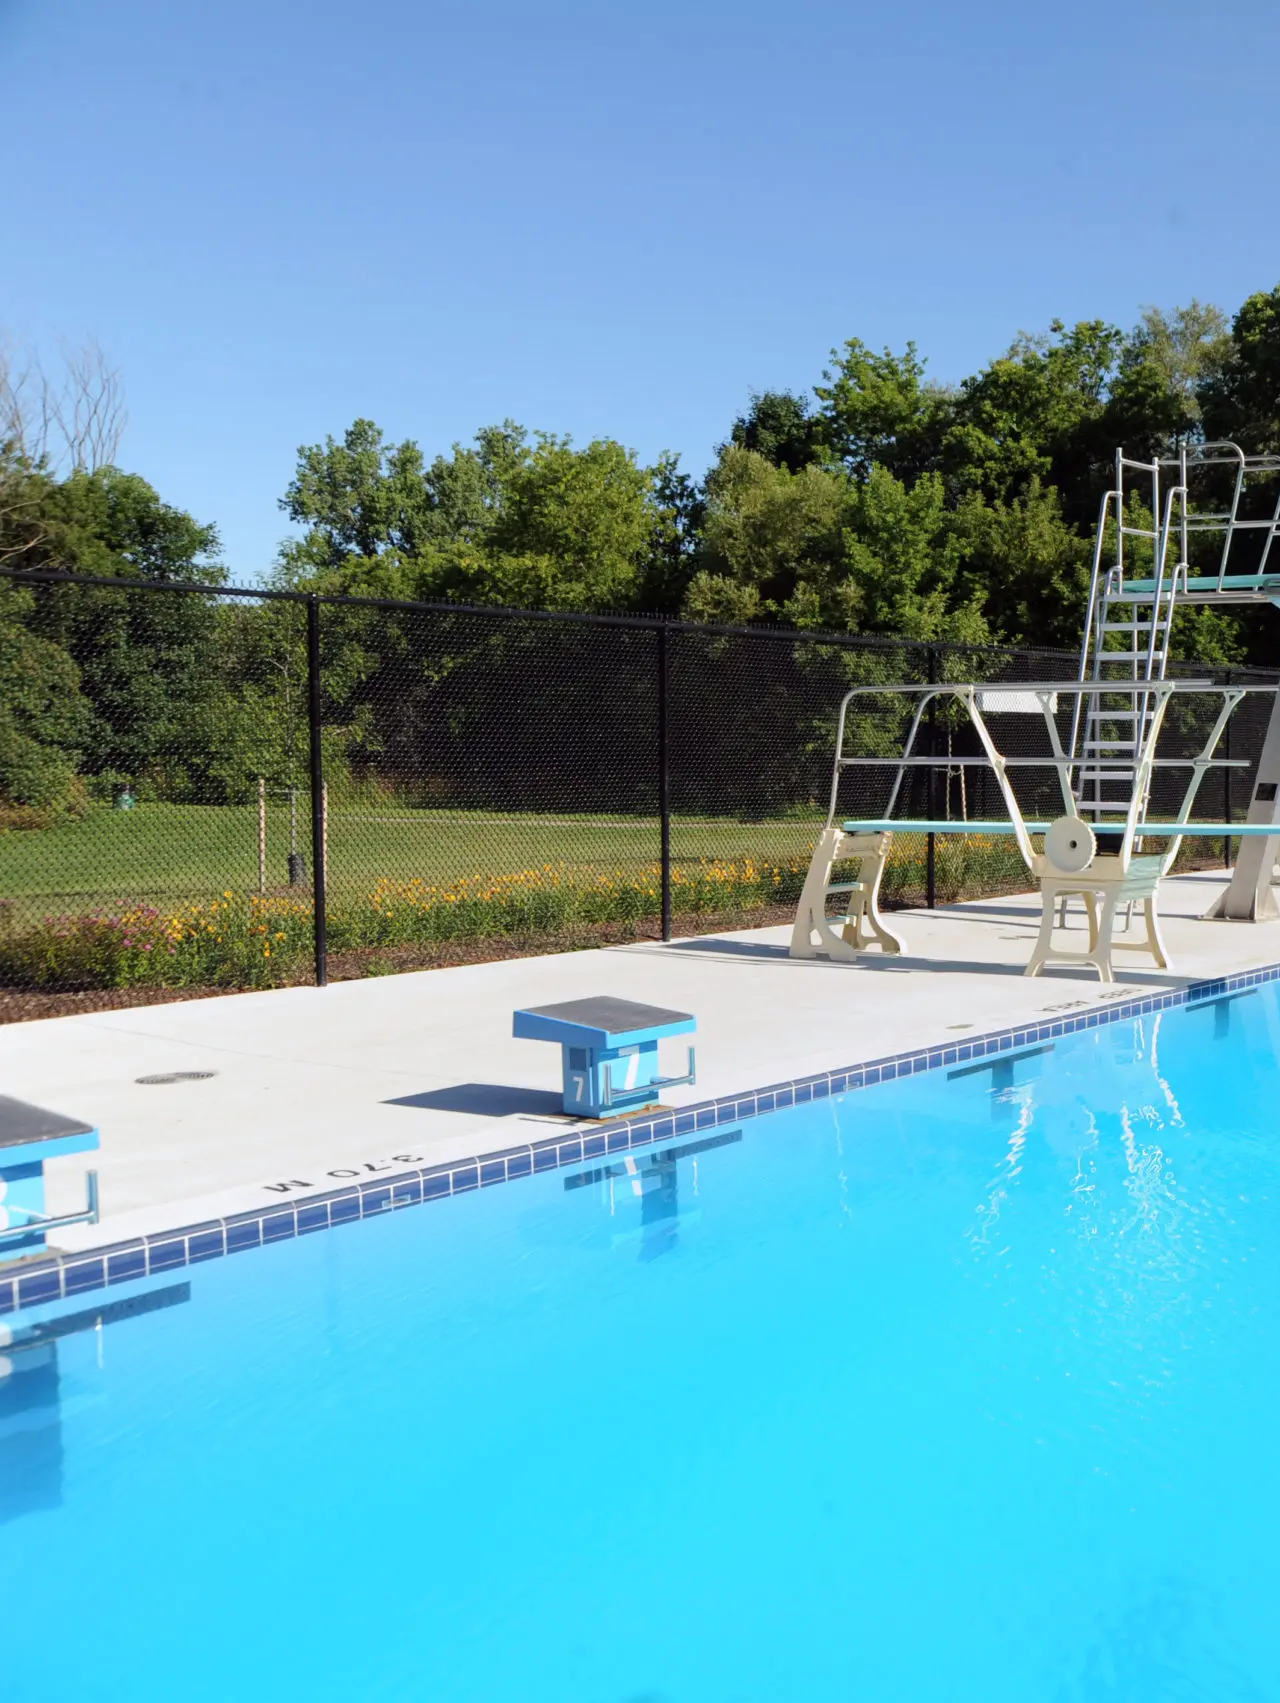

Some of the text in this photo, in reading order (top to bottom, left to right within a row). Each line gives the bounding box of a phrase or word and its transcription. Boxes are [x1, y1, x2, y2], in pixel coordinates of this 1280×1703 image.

[618, 1045, 640, 1091] 7
[573, 1076, 584, 1102] 7
[263, 1179, 315, 1193] M
